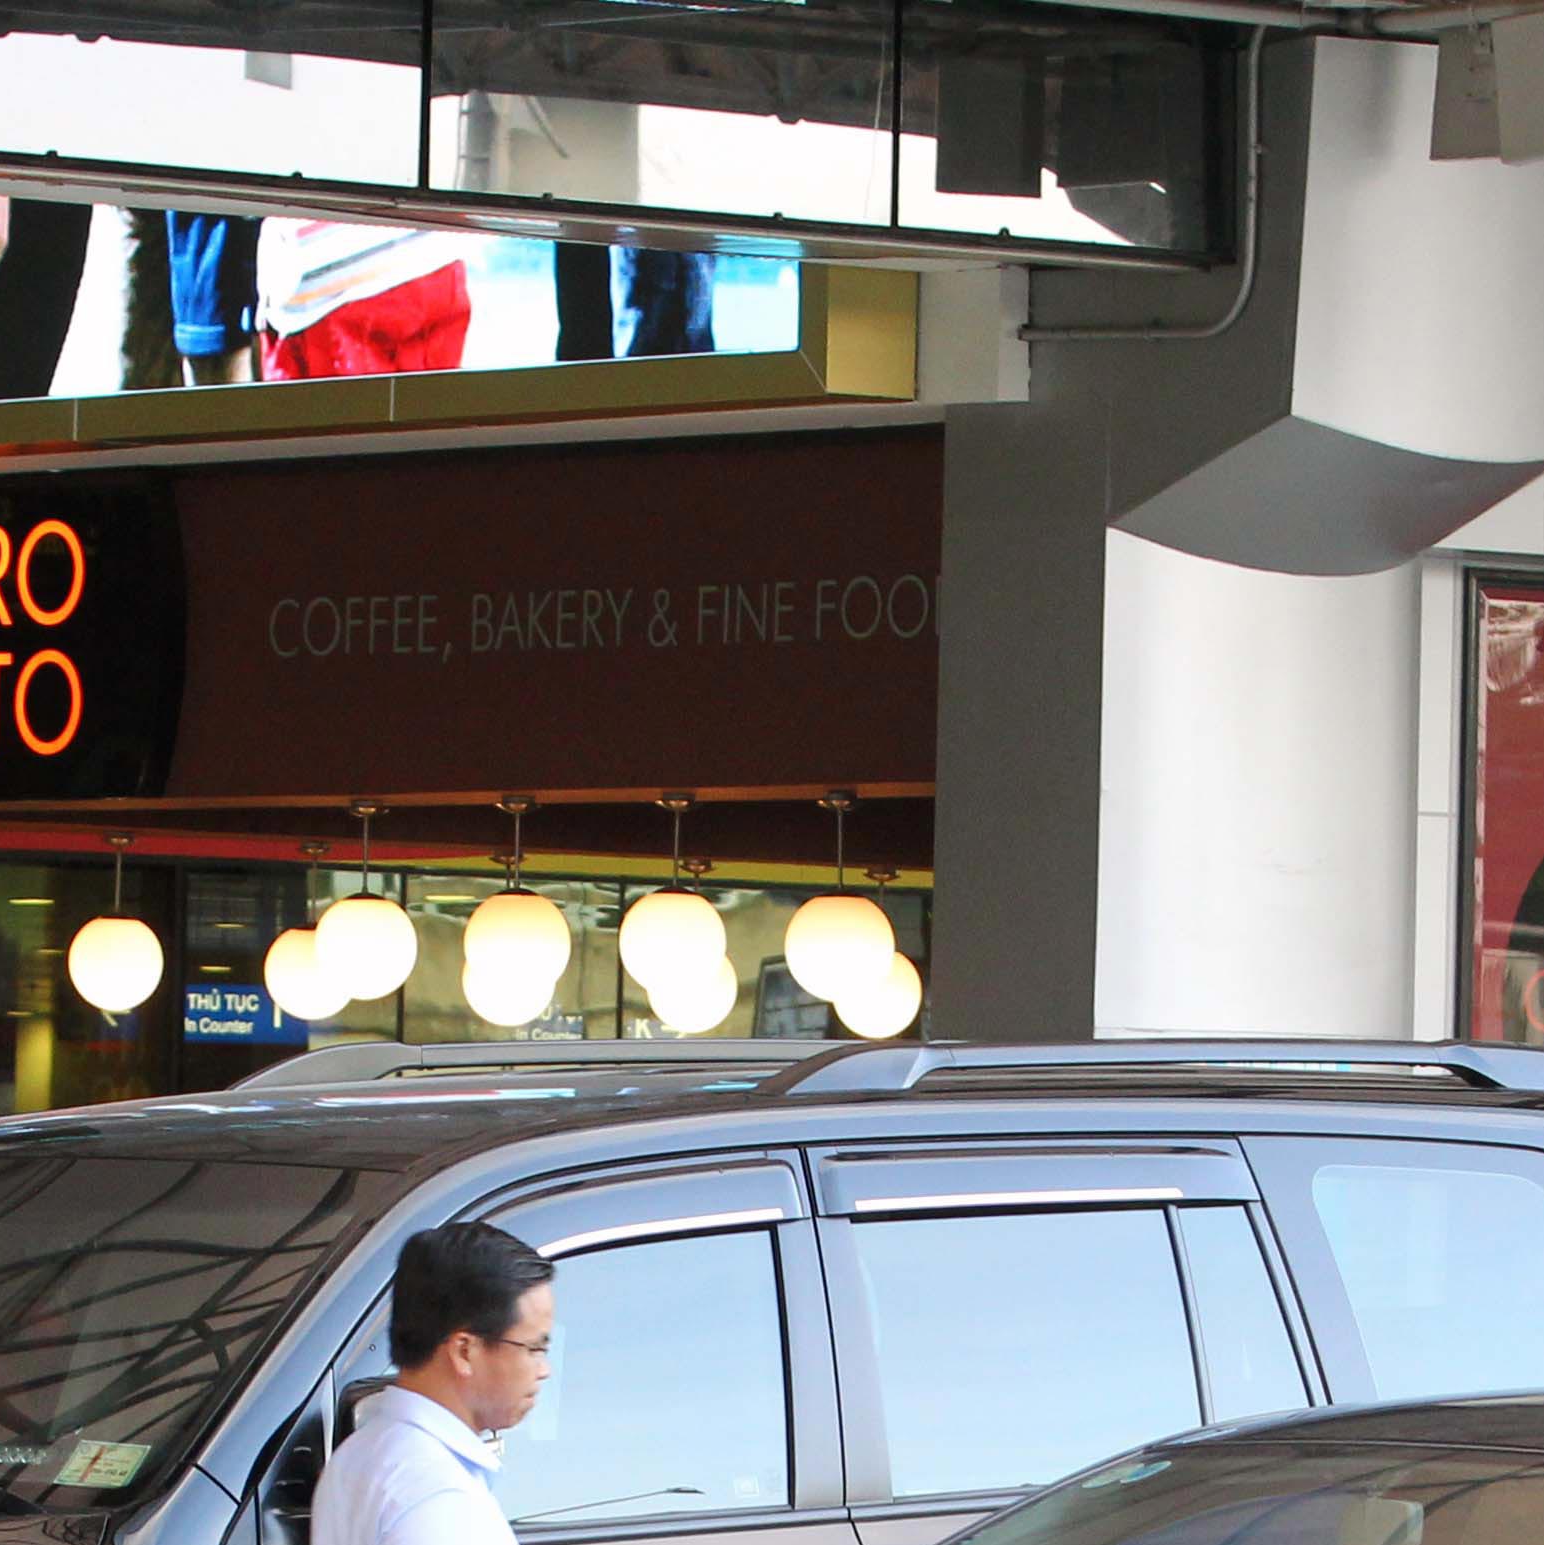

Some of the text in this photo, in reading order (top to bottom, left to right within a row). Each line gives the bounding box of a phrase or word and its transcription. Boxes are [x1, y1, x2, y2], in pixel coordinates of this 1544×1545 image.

[268, 574, 941, 664] COFFEE, BAKERY & FINE FOO
[187, 987, 222, 1011] THỦ
[199, 1016, 253, 1034] Counter
